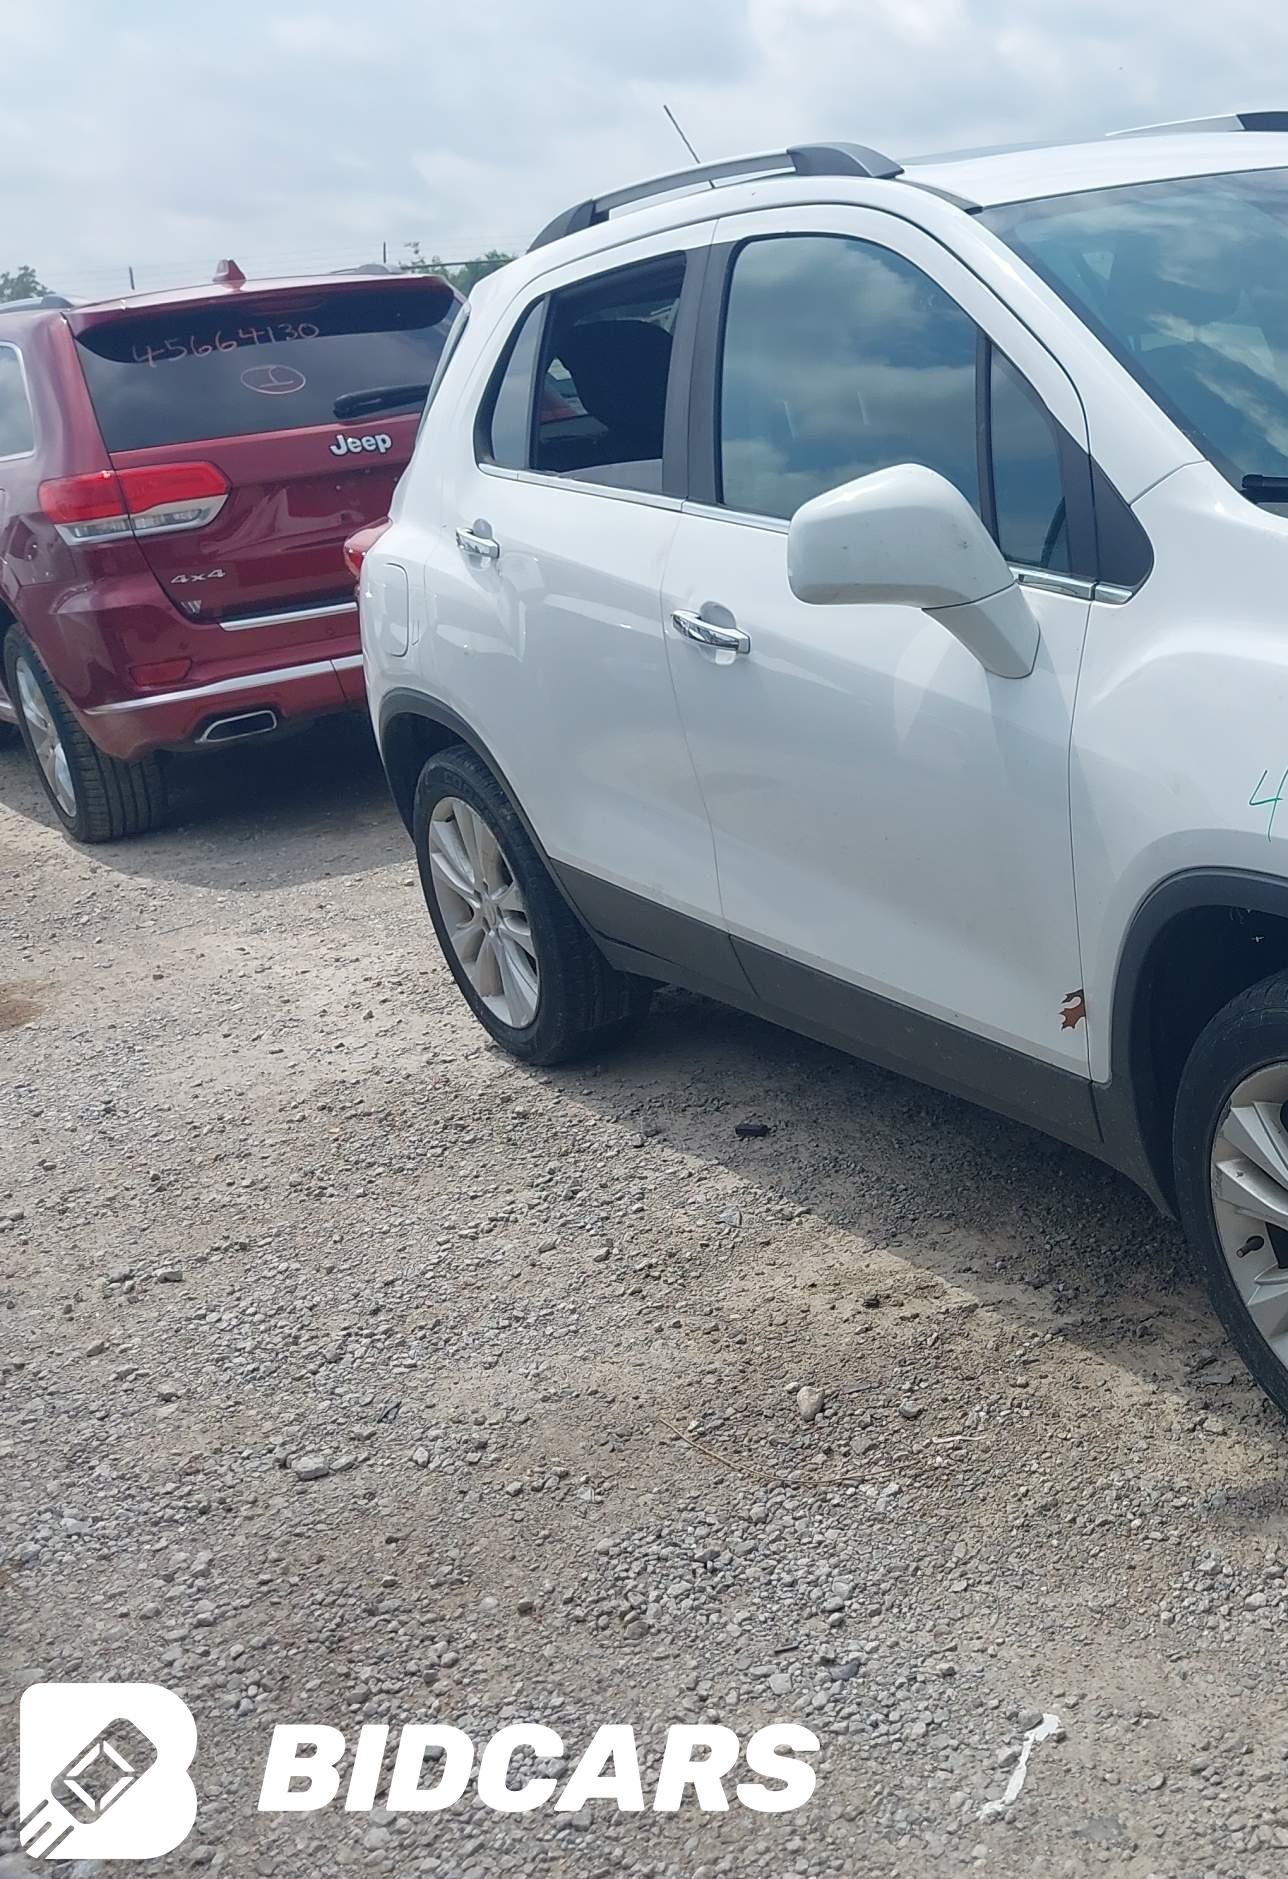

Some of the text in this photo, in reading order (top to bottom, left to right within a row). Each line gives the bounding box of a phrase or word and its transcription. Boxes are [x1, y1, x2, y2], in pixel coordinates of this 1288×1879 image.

[132, 323, 320, 368] 45664130
[329, 433, 392, 456] Jeep
[170, 568, 226, 583] 4x4
